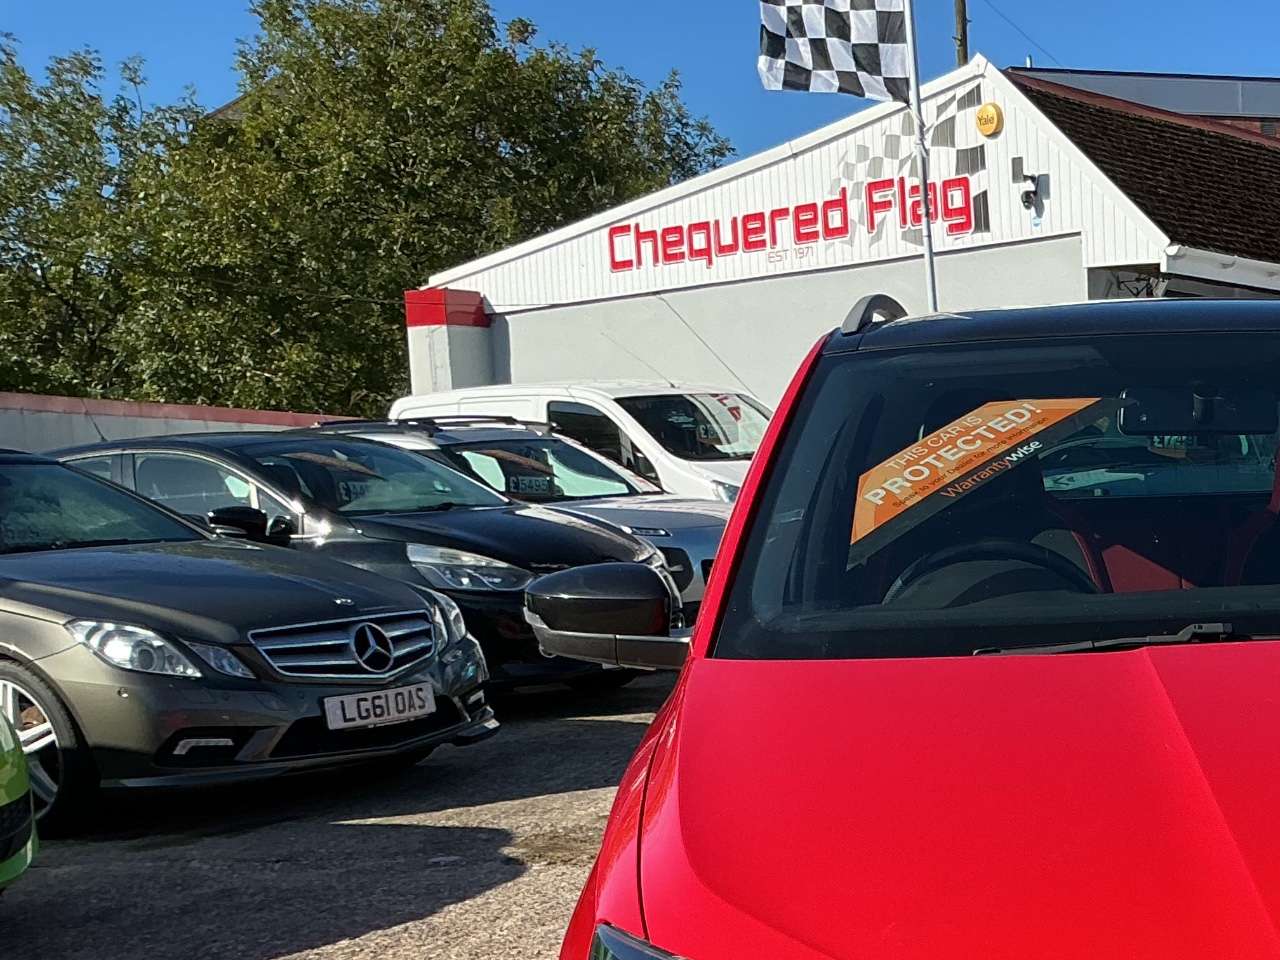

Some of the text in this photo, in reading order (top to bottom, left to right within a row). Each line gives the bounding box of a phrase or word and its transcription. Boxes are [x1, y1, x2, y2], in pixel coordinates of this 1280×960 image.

[977, 113, 995, 126] Yale
[608, 175, 974, 273] Chequered Flag
[767, 246, 814, 263] EST 1971
[864, 402, 1042, 506] PROTECTED!
[885, 415, 983, 470] THIS CAR IS
[940, 439, 1043, 498] Warrantywise
[340, 687, 426, 723] LG61 OAS
